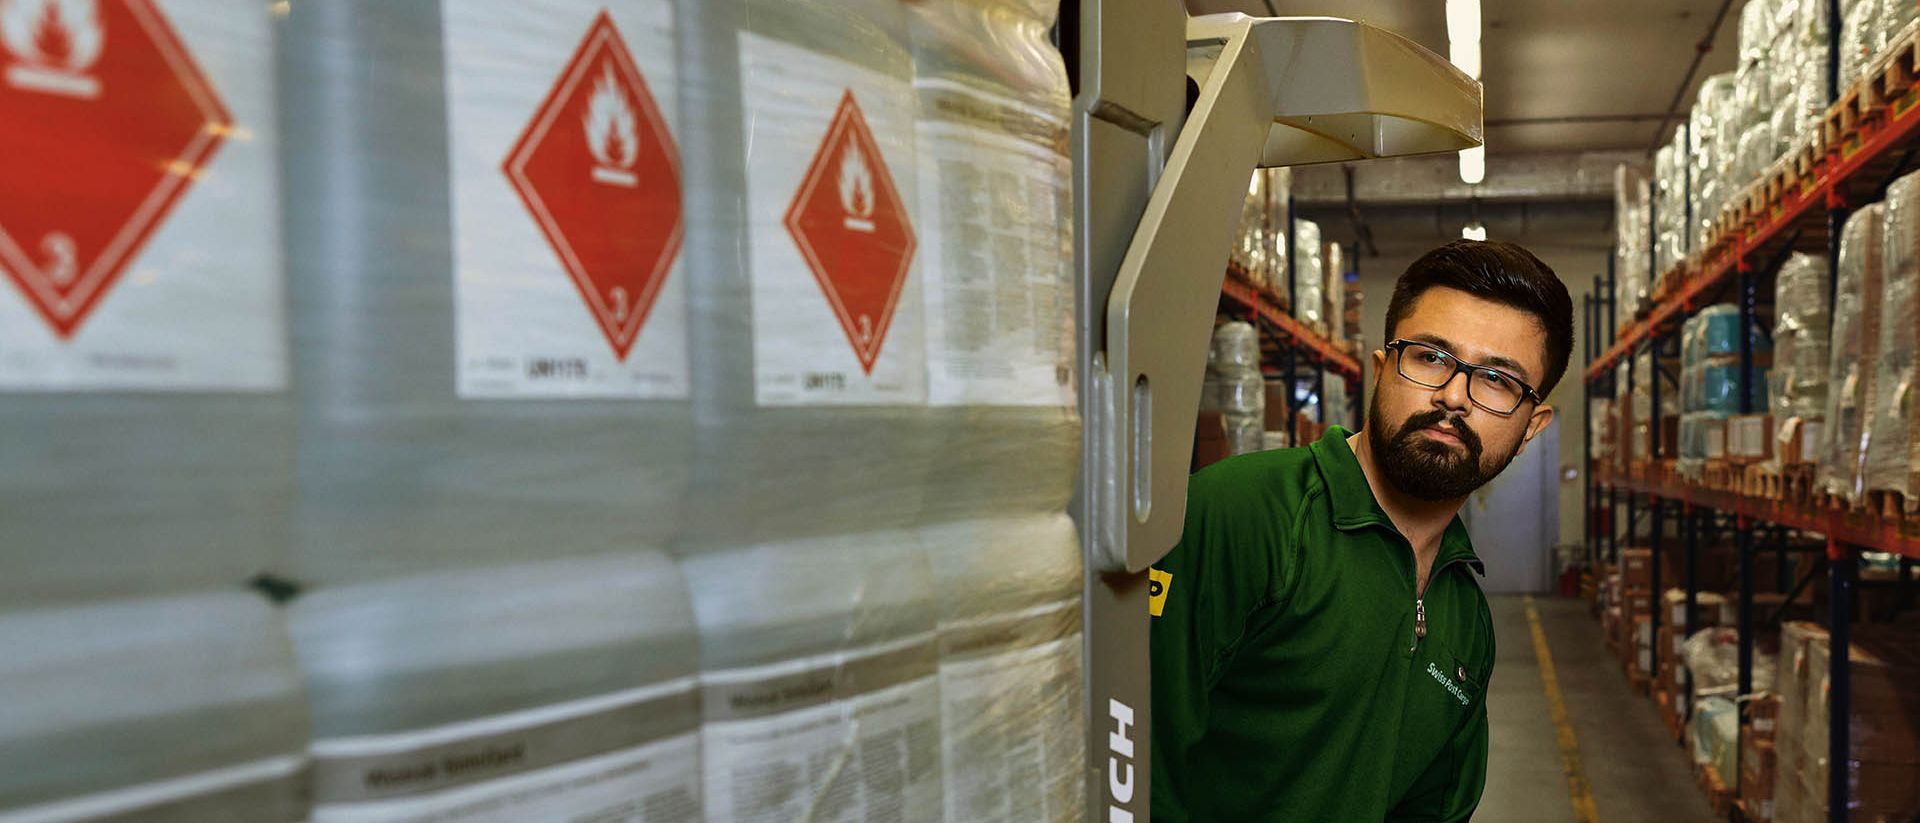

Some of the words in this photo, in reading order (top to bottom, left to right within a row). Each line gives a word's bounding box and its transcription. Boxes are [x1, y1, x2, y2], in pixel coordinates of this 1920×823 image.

[40, 232, 78, 284] 3
[609, 286, 628, 321] 3
[1427, 662, 1447, 685] Swiss
[1444, 679, 1459, 696] Post
